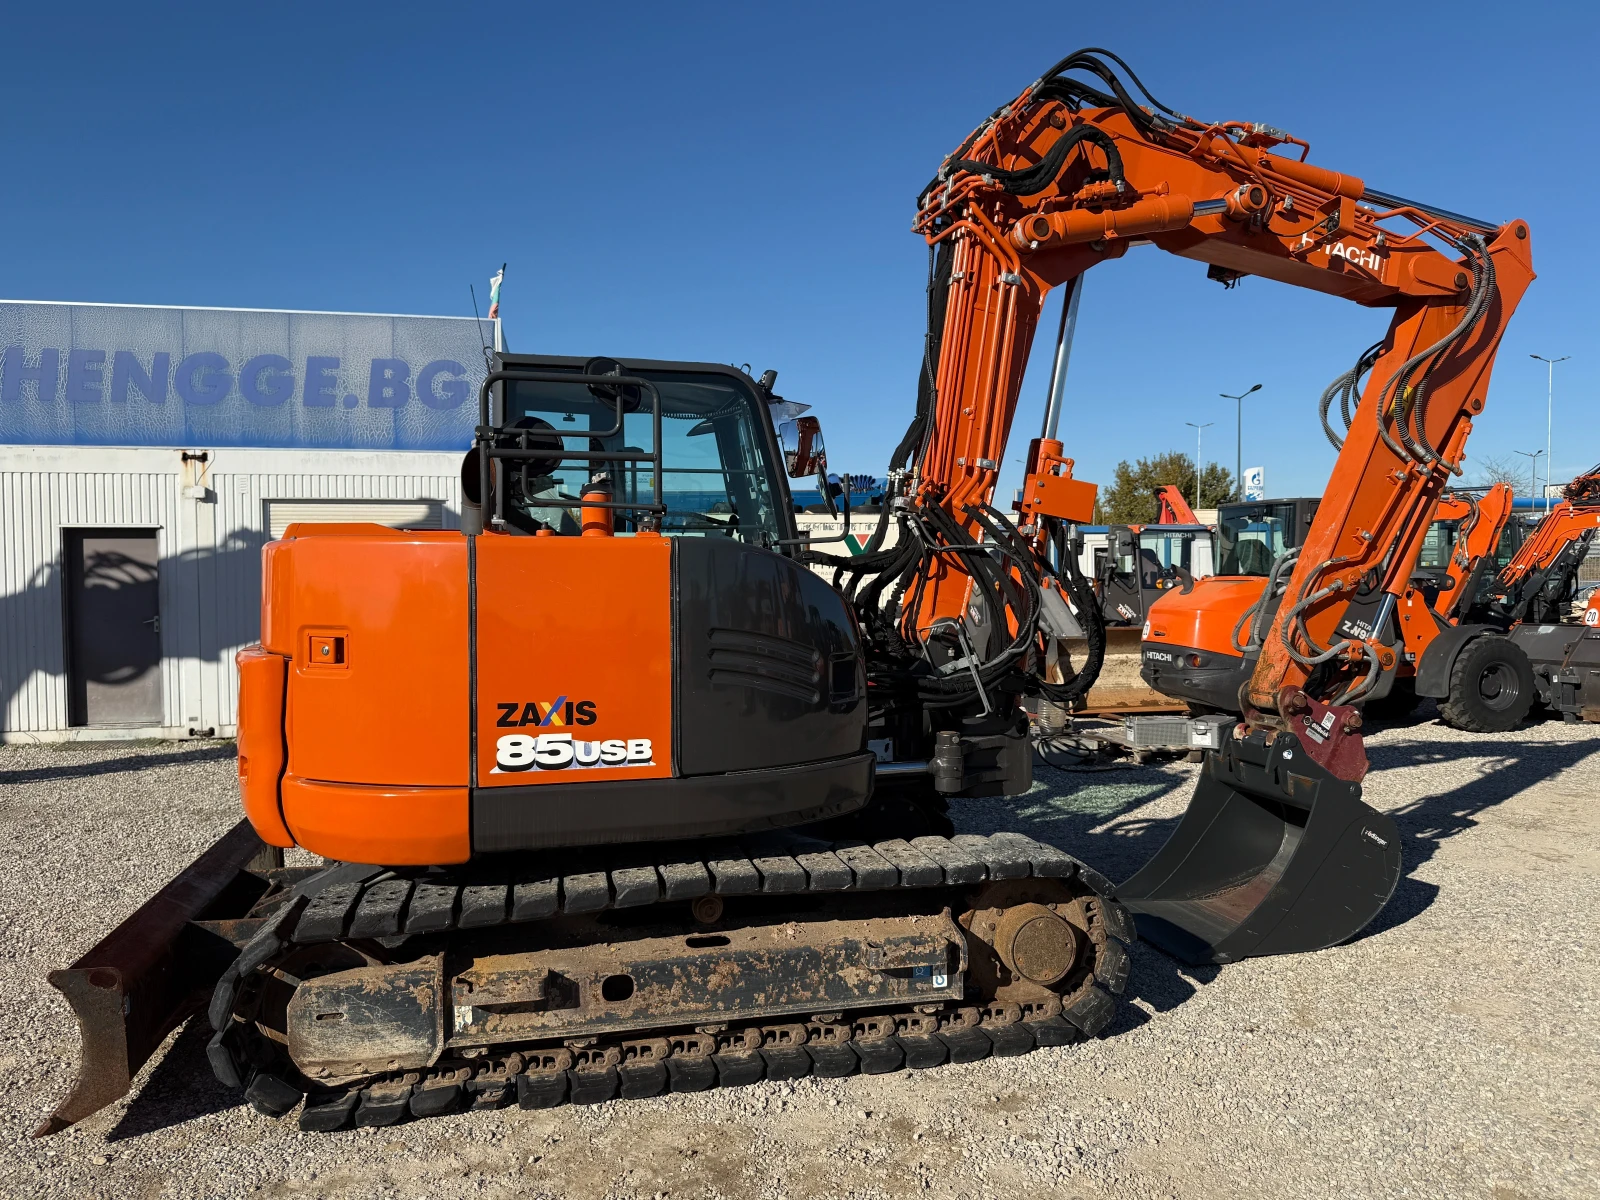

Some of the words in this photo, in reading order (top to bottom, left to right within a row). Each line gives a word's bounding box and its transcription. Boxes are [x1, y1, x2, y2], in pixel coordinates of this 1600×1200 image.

[1, 346, 471, 411] HENGGE.BG
[1356, 619, 1372, 631] HITA
[1586, 611, 1597, 622] 20
[1146, 650, 1172, 662] HITACHI
[496, 695, 597, 727] ZAXIS
[496, 733, 653, 772] 85USB
